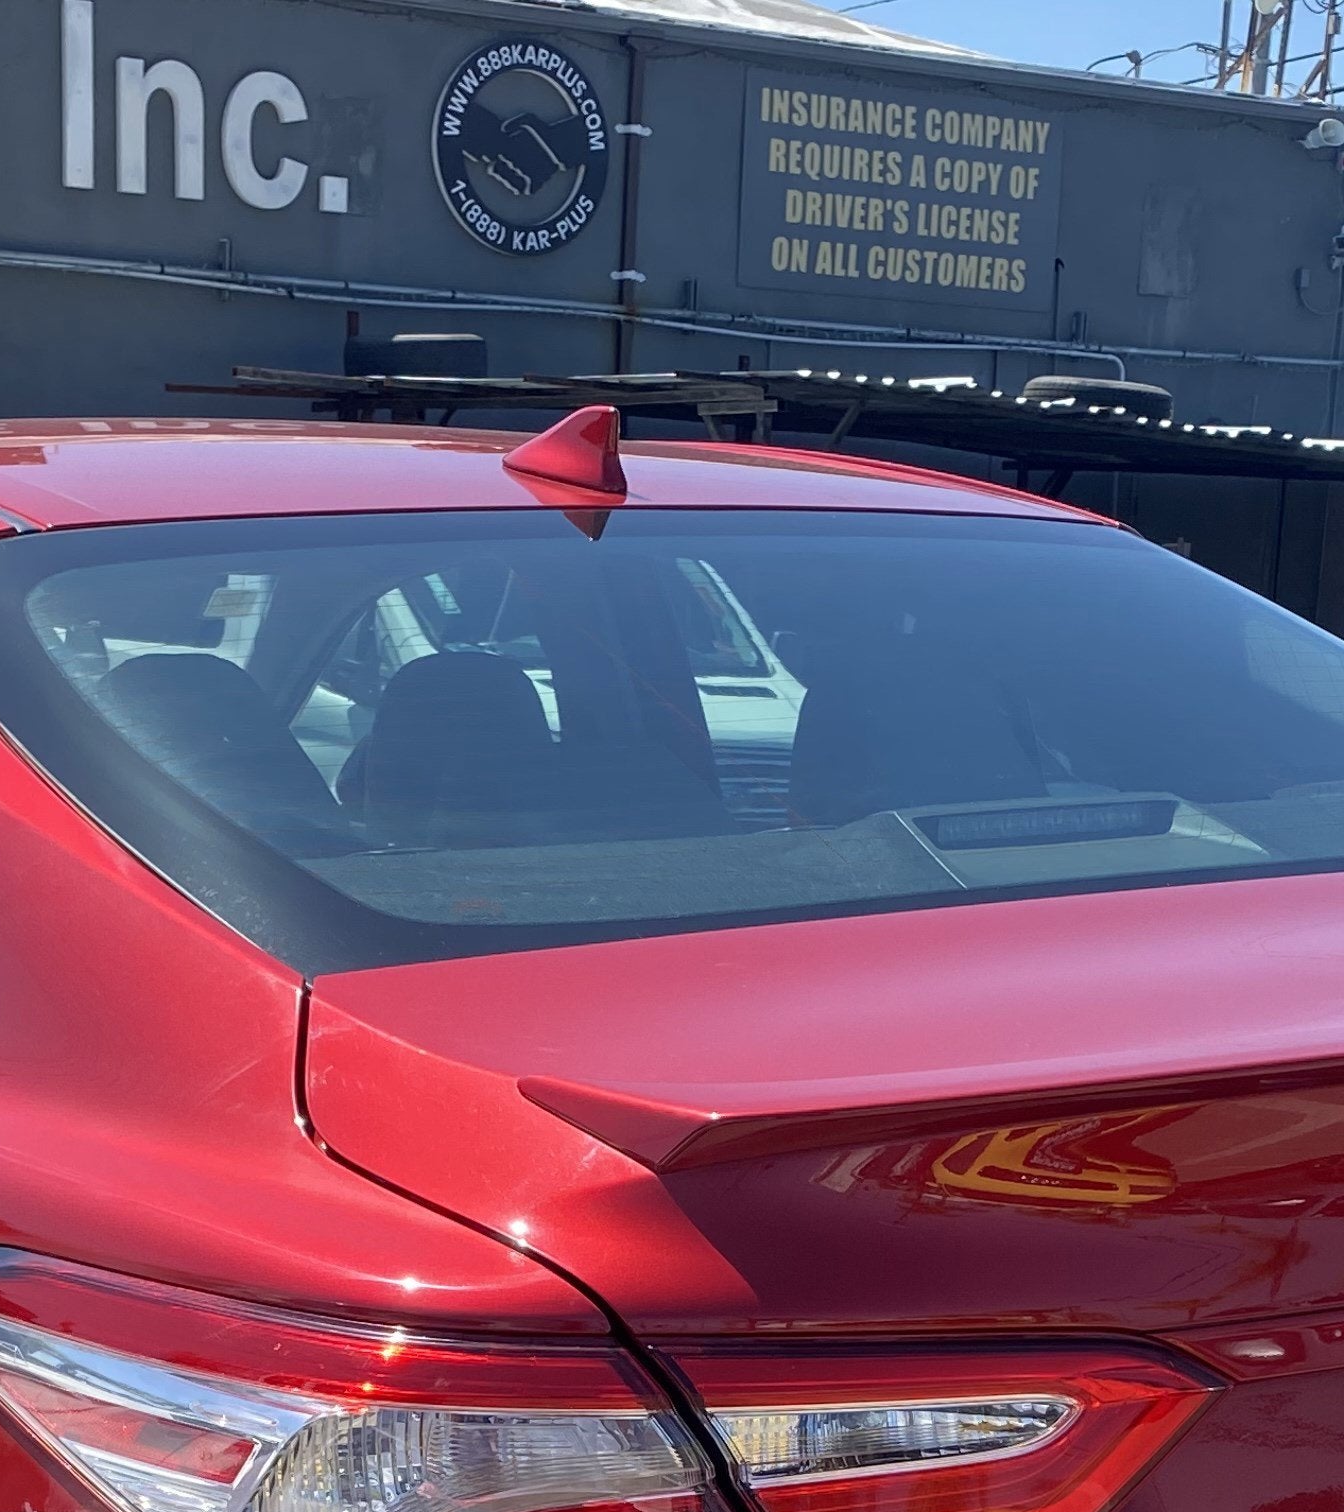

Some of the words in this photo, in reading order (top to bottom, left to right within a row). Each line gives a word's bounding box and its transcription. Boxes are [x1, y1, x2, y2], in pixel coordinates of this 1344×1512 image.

[62, 0, 348, 213] Inc.
[443, 44, 605, 150] WWW.888KARPLUS.COM
[761, 87, 917, 140] INSURANCE
[925, 108, 1050, 154] COMPANY
[768, 138, 902, 186] REQUIRES
[909, 155, 926, 189] A
[934, 157, 1003, 196] COPY
[1010, 165, 1040, 200] OF
[450, 179, 506, 244] 1-(888)
[512, 195, 594, 251] KAR-PLUS
[785, 189, 910, 235] DRIVER'S
[917, 203, 1020, 246] LICENSE
[771, 236, 808, 273] ON
[814, 241, 859, 278] ALL
[867, 245, 1027, 294] CUSTOMERS
